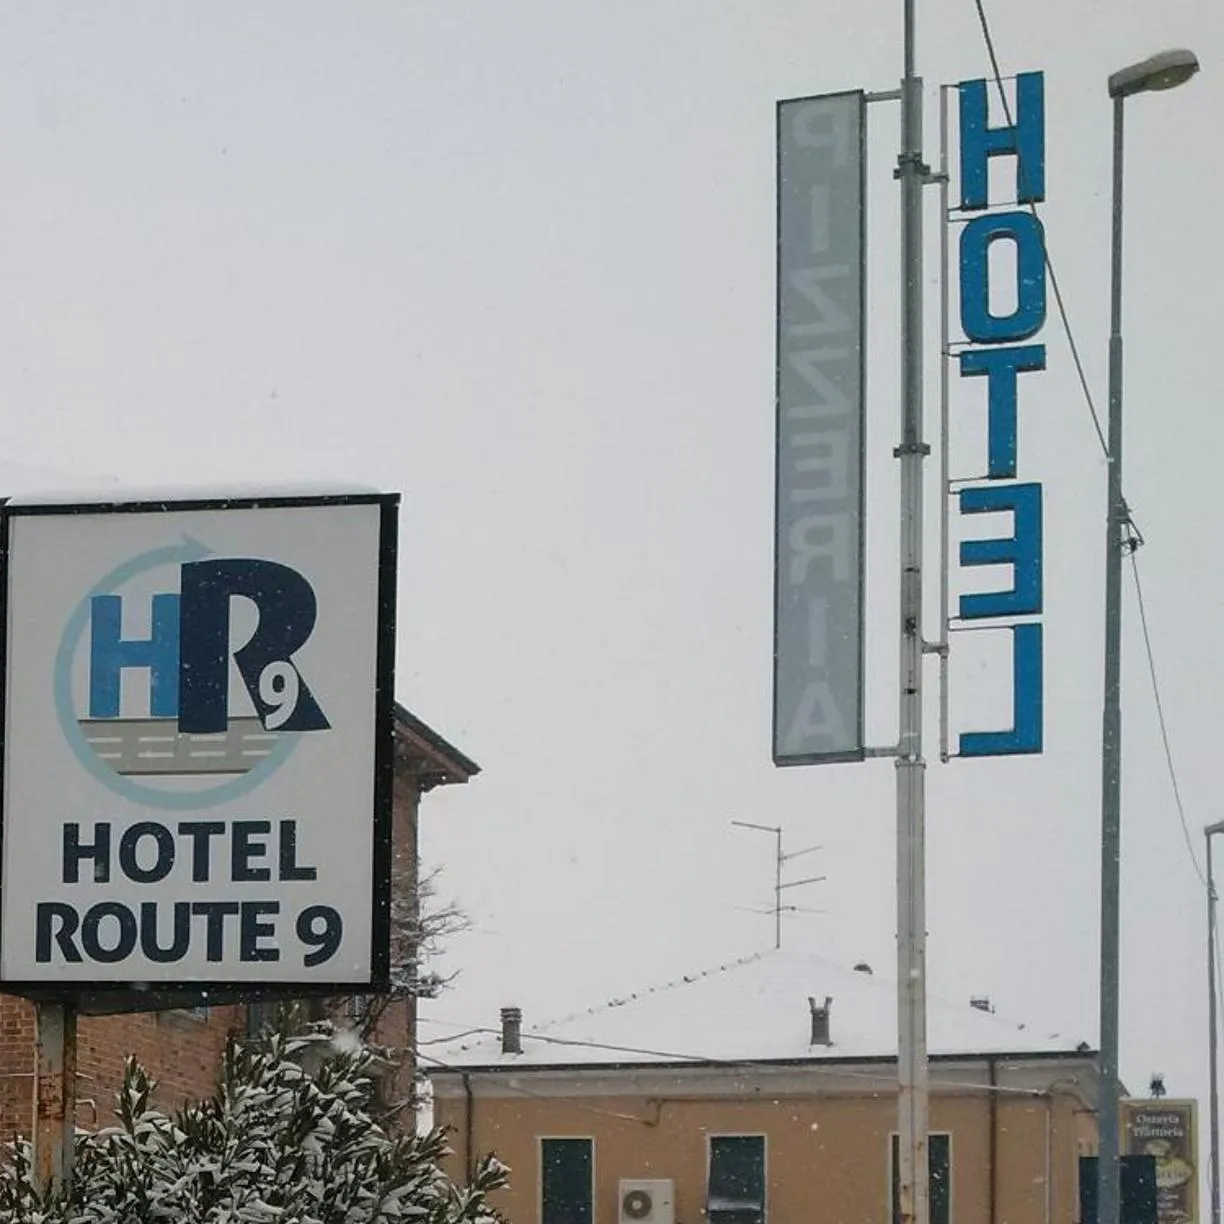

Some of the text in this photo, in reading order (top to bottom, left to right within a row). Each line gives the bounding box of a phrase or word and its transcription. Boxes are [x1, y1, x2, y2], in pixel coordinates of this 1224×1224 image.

[63, 820, 317, 884] HOTEL
[35, 901, 343, 967] ROUTE 9
